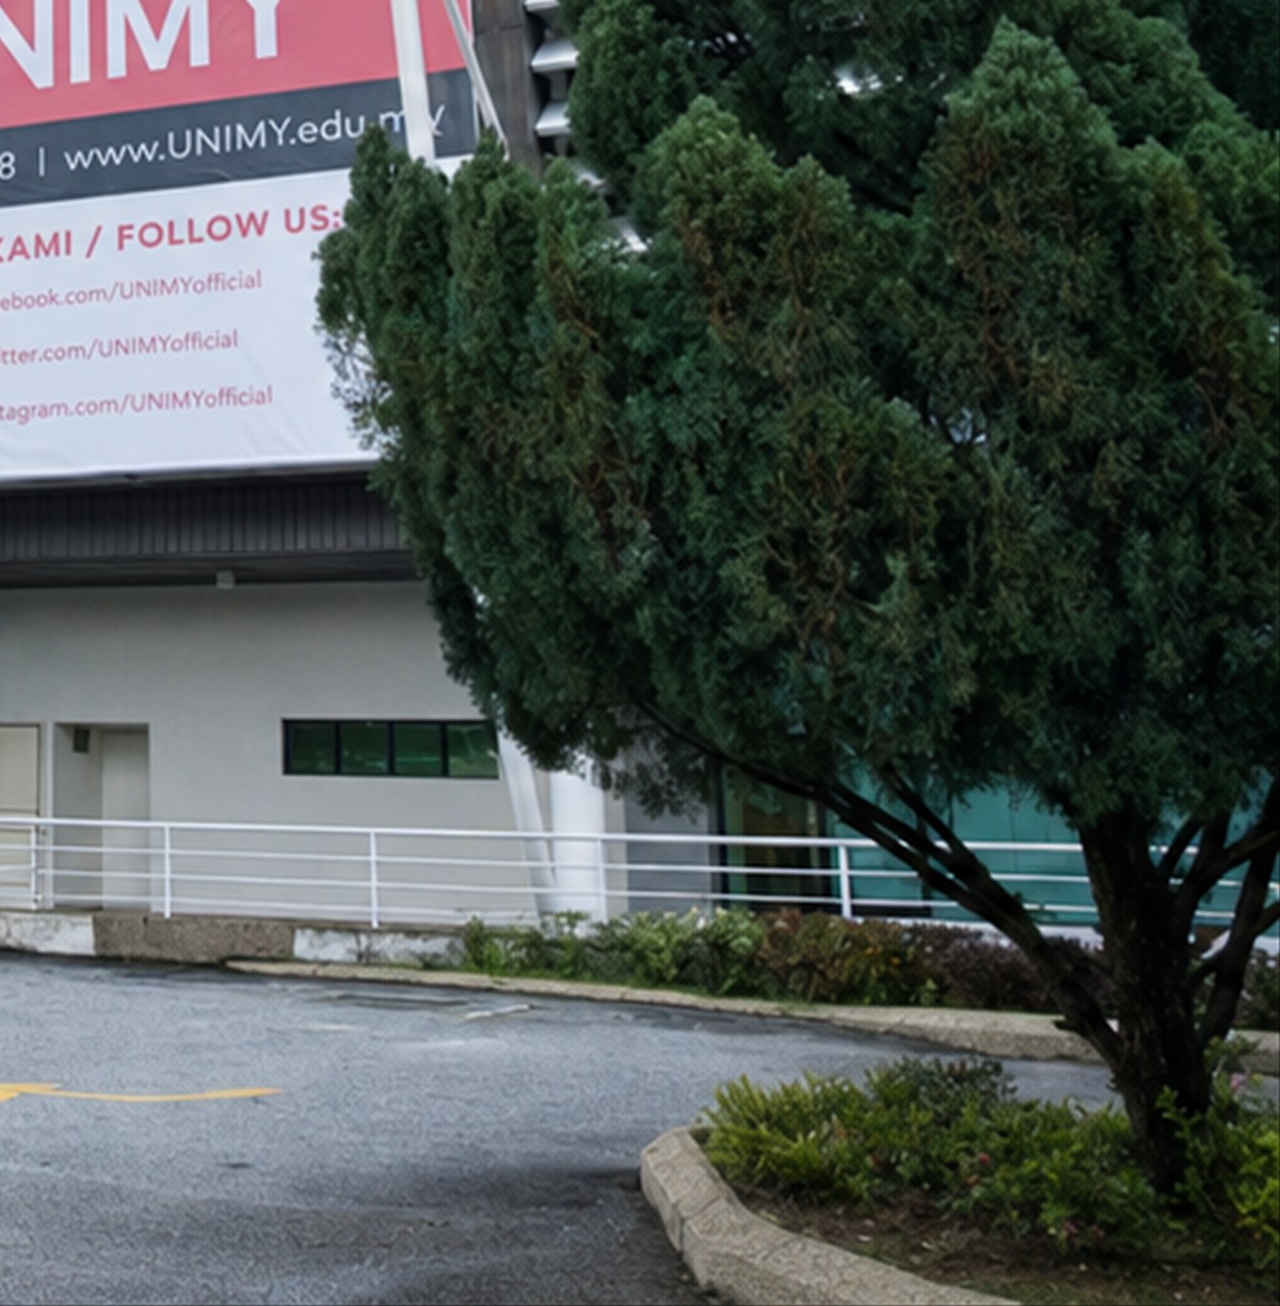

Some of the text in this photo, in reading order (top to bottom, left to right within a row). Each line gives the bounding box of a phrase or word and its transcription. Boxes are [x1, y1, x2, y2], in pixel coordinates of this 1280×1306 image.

[85, 224, 103, 259] /
[117, 210, 270, 251] FOLLOW
[284, 204, 341, 234] US:
